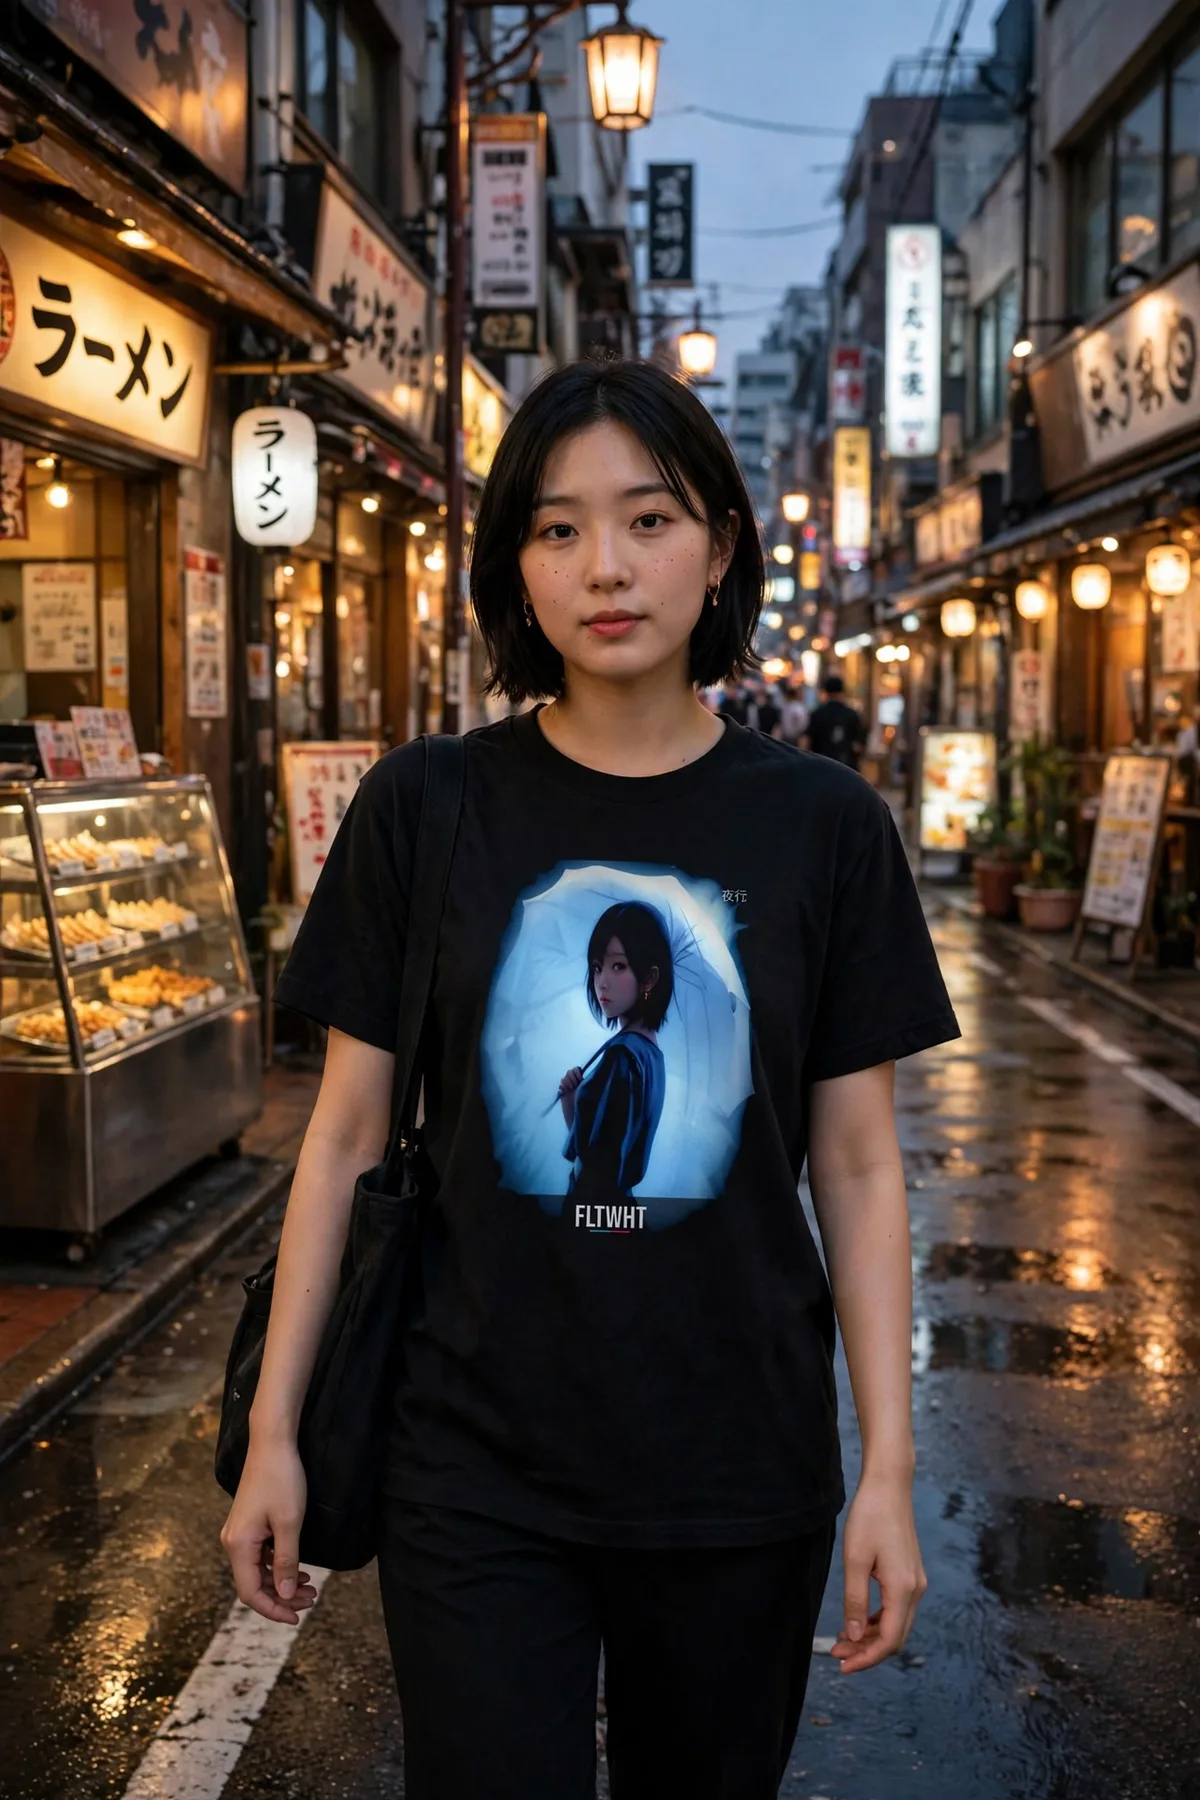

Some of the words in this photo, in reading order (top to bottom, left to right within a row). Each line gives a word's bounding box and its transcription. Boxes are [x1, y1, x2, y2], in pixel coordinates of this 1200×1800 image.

[32, 275, 193, 419] ラーメン
[253, 420, 288, 529] ラーメン
[575, 1204, 647, 1229] FLTWHT
